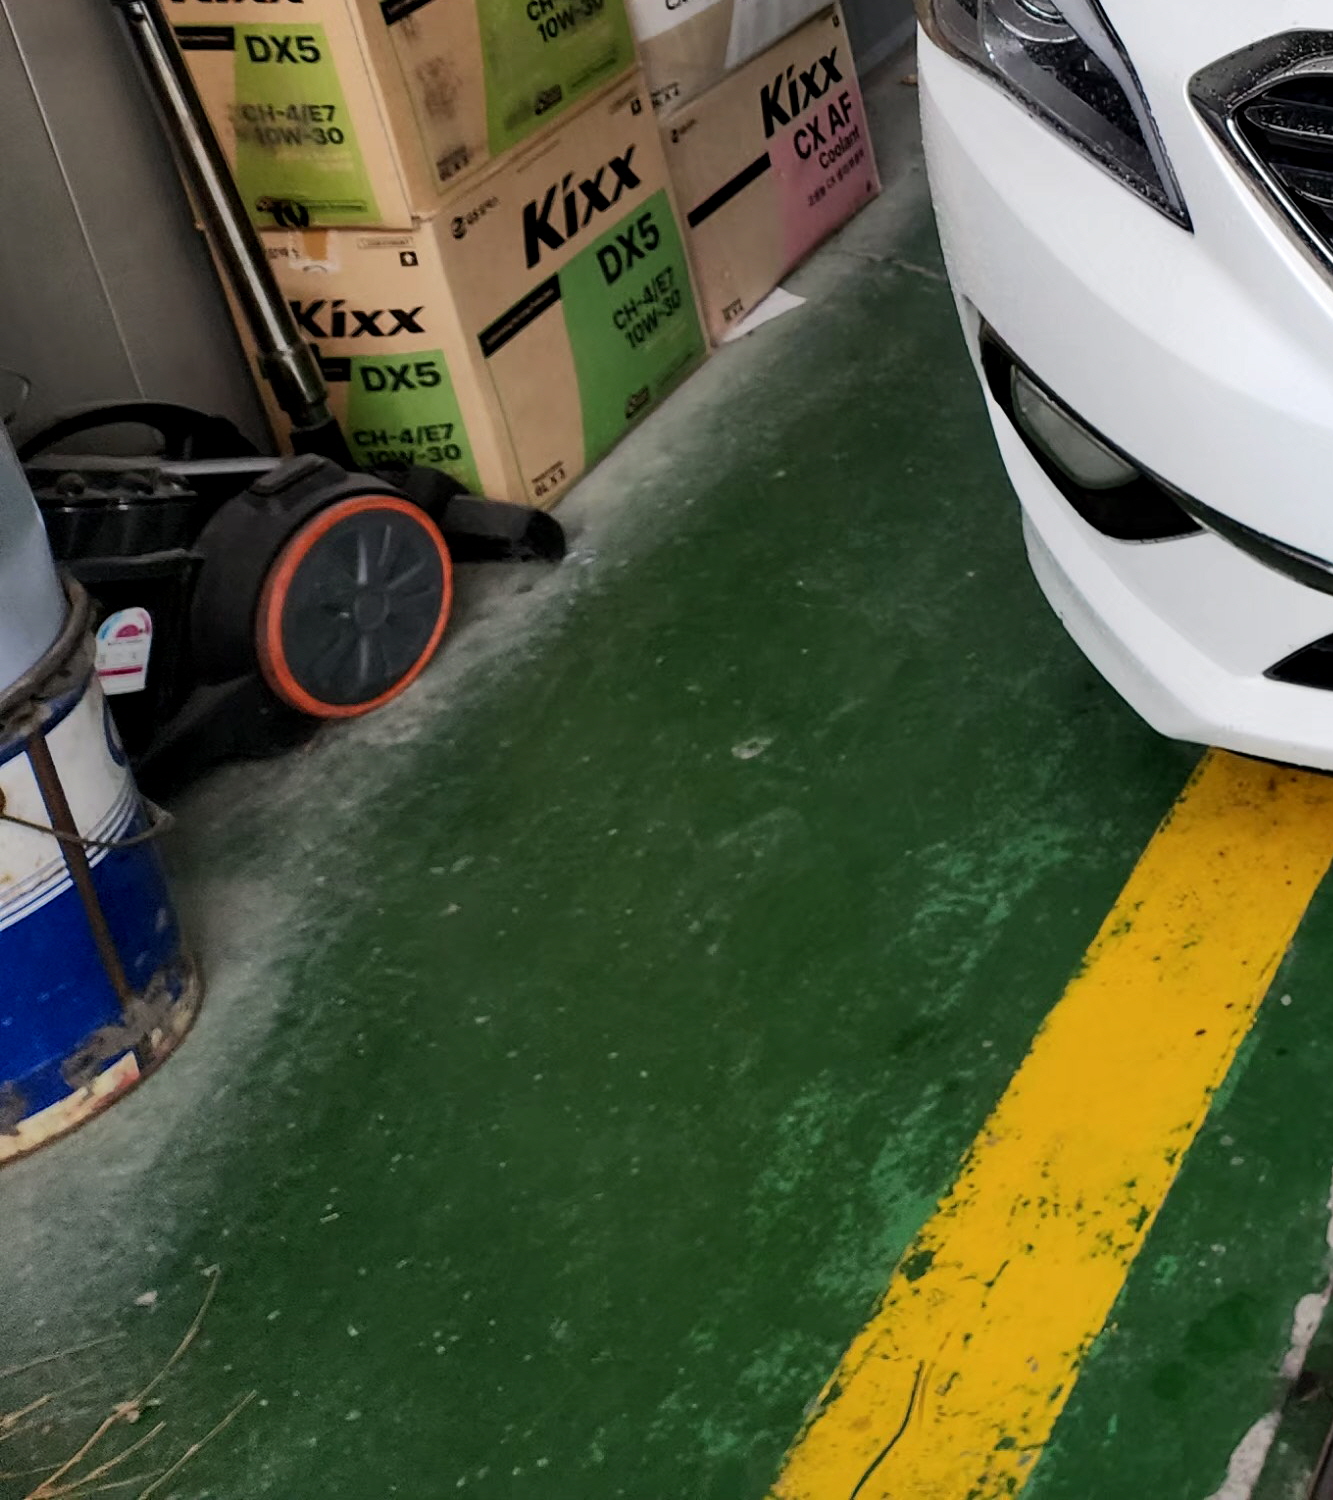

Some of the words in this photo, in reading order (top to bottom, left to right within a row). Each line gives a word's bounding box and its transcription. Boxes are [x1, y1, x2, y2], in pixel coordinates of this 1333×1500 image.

[244, 35, 321, 63] DX5
[242, 104, 336, 122] CH-4/E7
[760, 47, 843, 140] Kixx
[254, 126, 344, 146] 10W-30
[794, 106, 827, 161] CX
[829, 91, 853, 132] AF
[819, 125, 860, 169] Coolant
[523, 143, 641, 269] Kixx
[597, 212, 660, 285] DX5
[290, 299, 425, 338] Kixx
[612, 266, 673, 330] CH-4/E7
[625, 289, 681, 349] 10W-30
[359, 361, 441, 392] DX5
[353, 423, 454, 446] CH-4/E7
